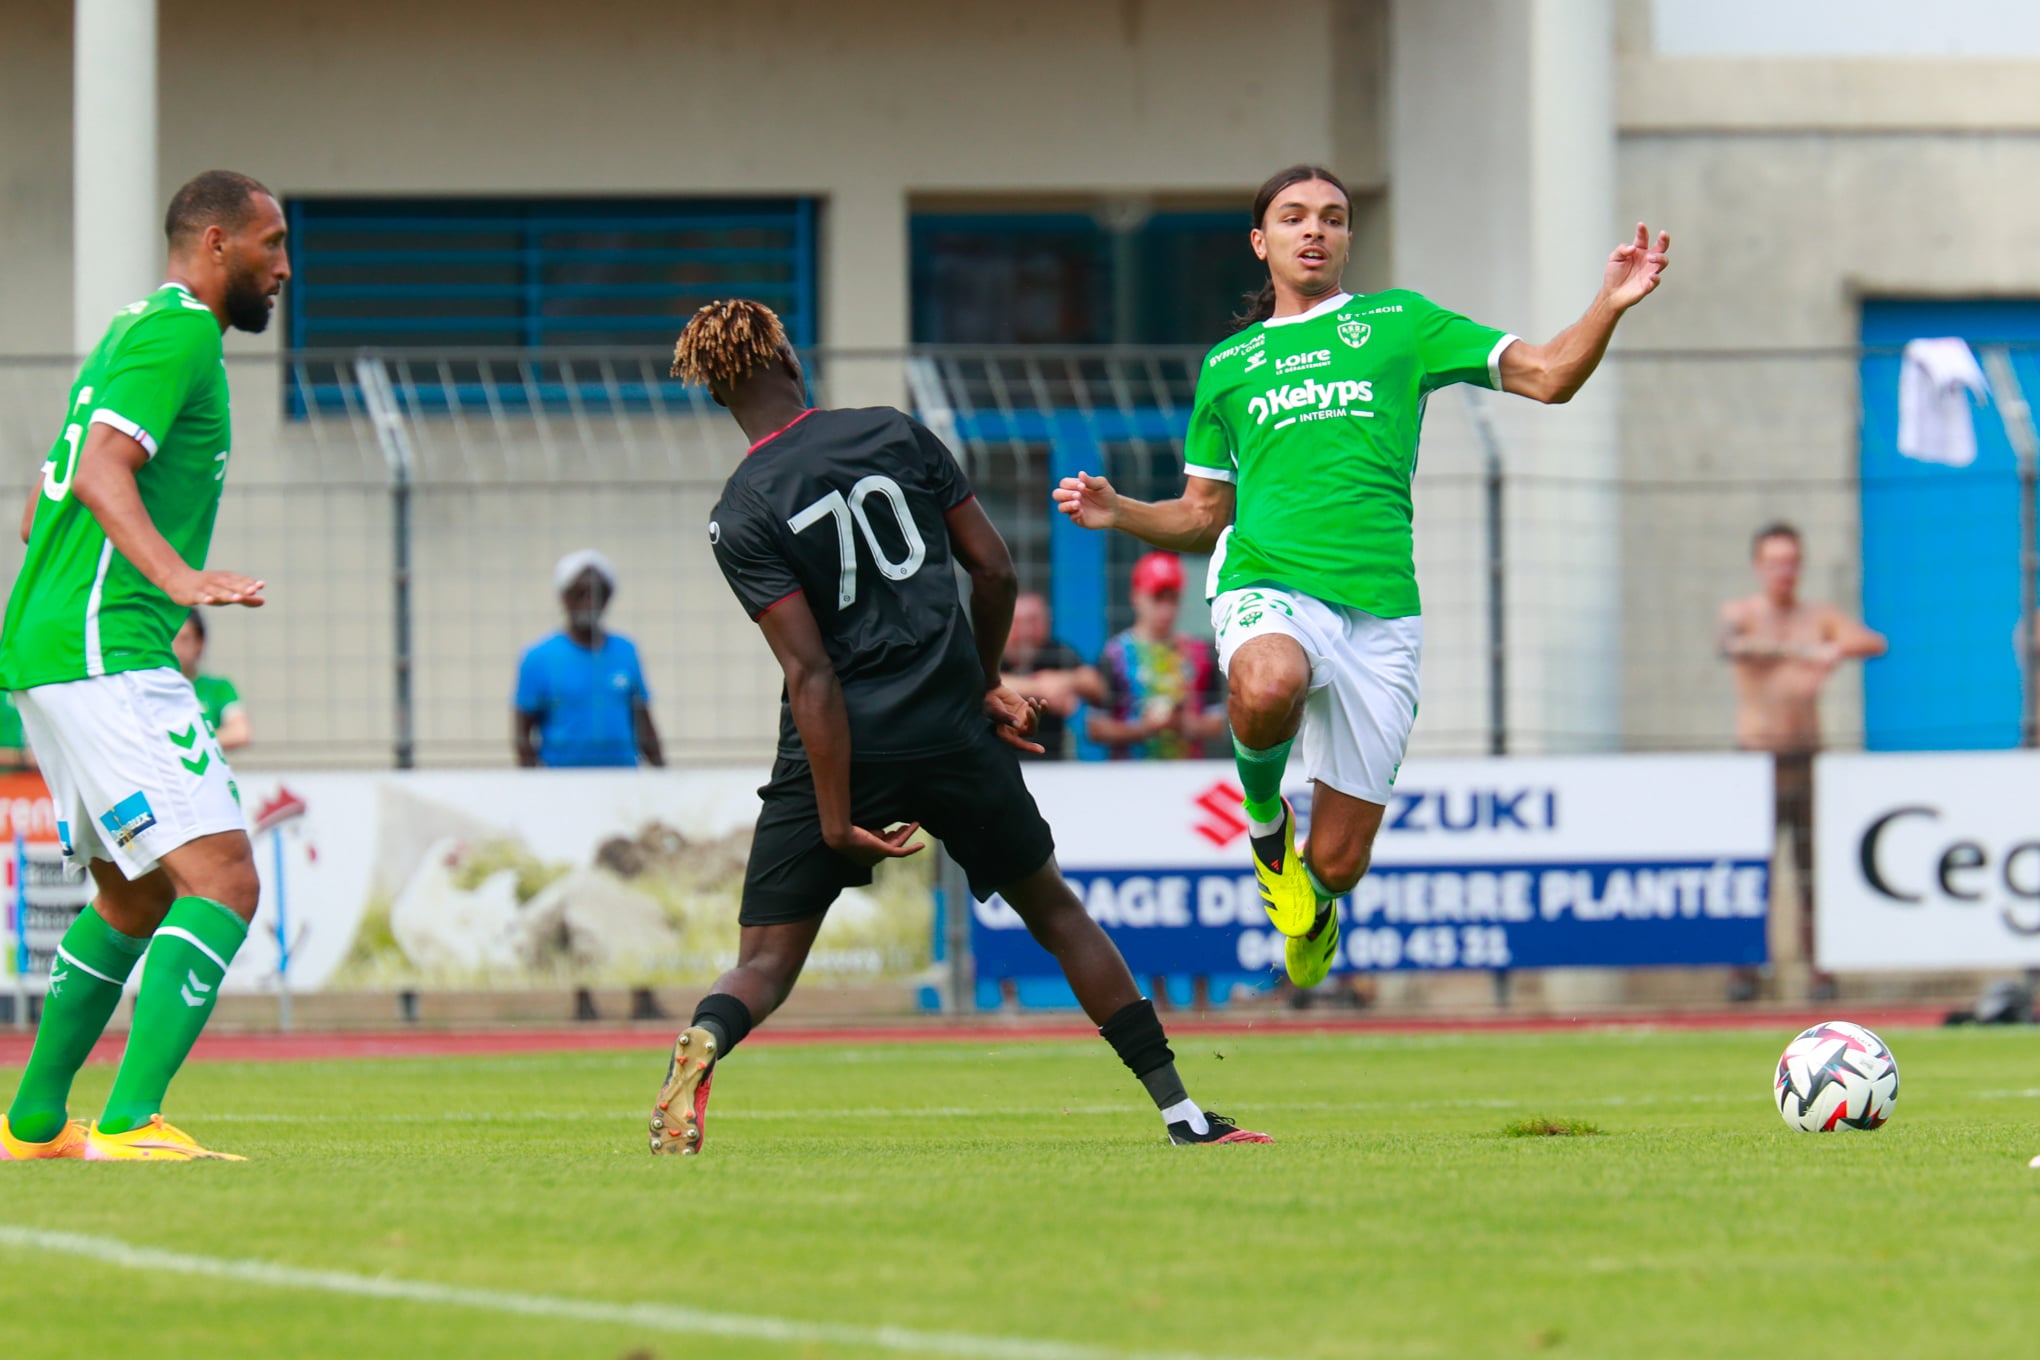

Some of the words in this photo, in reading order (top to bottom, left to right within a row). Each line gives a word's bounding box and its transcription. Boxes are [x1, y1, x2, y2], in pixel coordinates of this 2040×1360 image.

[1266, 378, 1373, 415] Kelyps
[1299, 408, 1347, 422] INTERIM
[787, 475, 926, 611] 70
[1287, 790, 1556, 832] SZUKI
[974, 876, 1190, 929] GAGE
[1352, 870, 1534, 922] PIERRE
[1540, 860, 1766, 921] PLANTÉE
